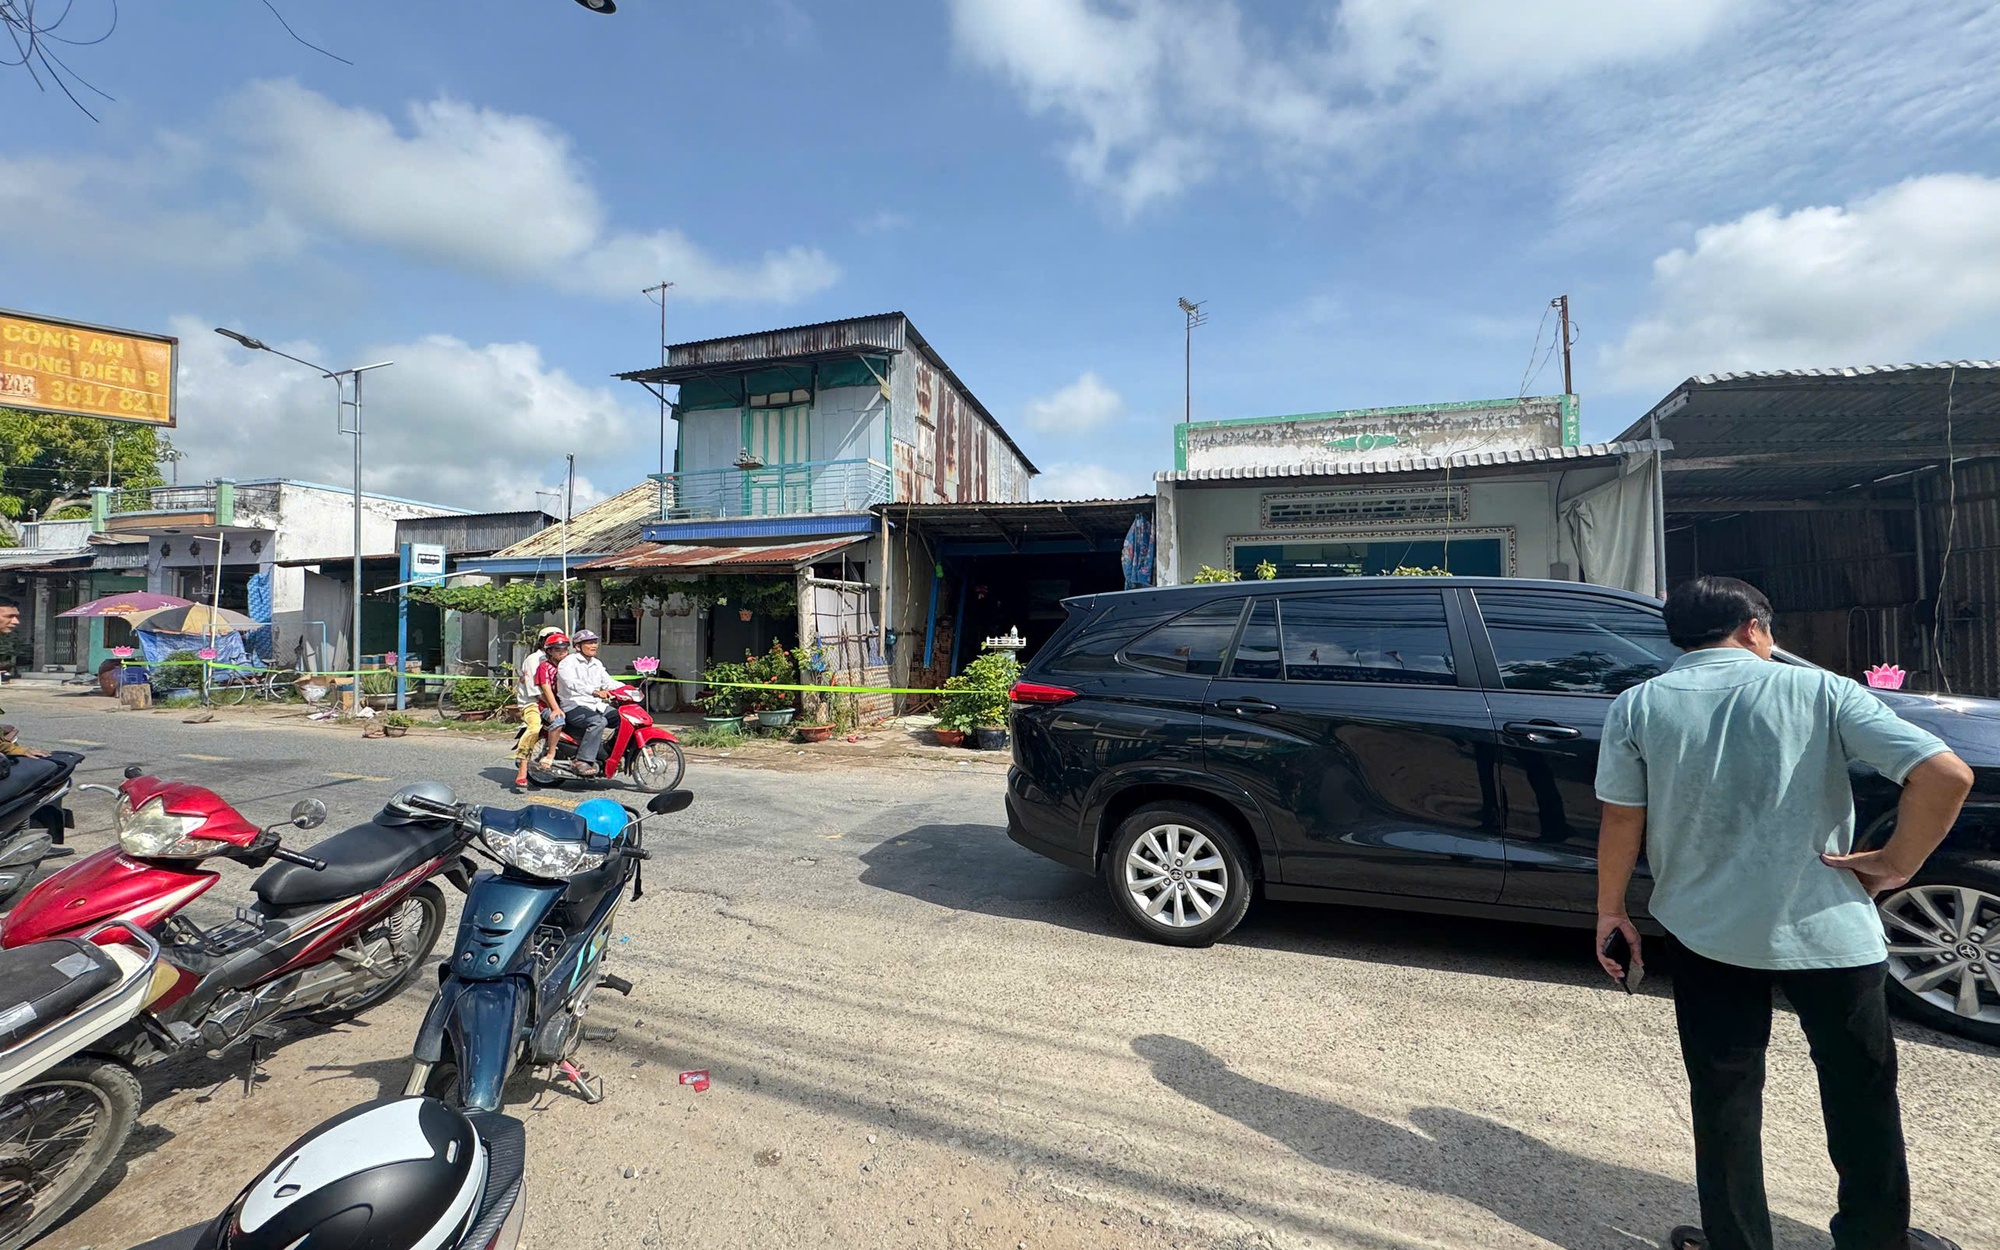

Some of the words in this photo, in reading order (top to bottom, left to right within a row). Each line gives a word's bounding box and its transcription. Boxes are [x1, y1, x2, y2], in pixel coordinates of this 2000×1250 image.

[3, 324, 80, 352] CÔNG
[89, 337, 124, 358] AN
[4, 350, 71, 375] LONG
[145, 370, 160, 387] B
[51, 380, 112, 408] 3617
[119, 390, 160, 415] 821
